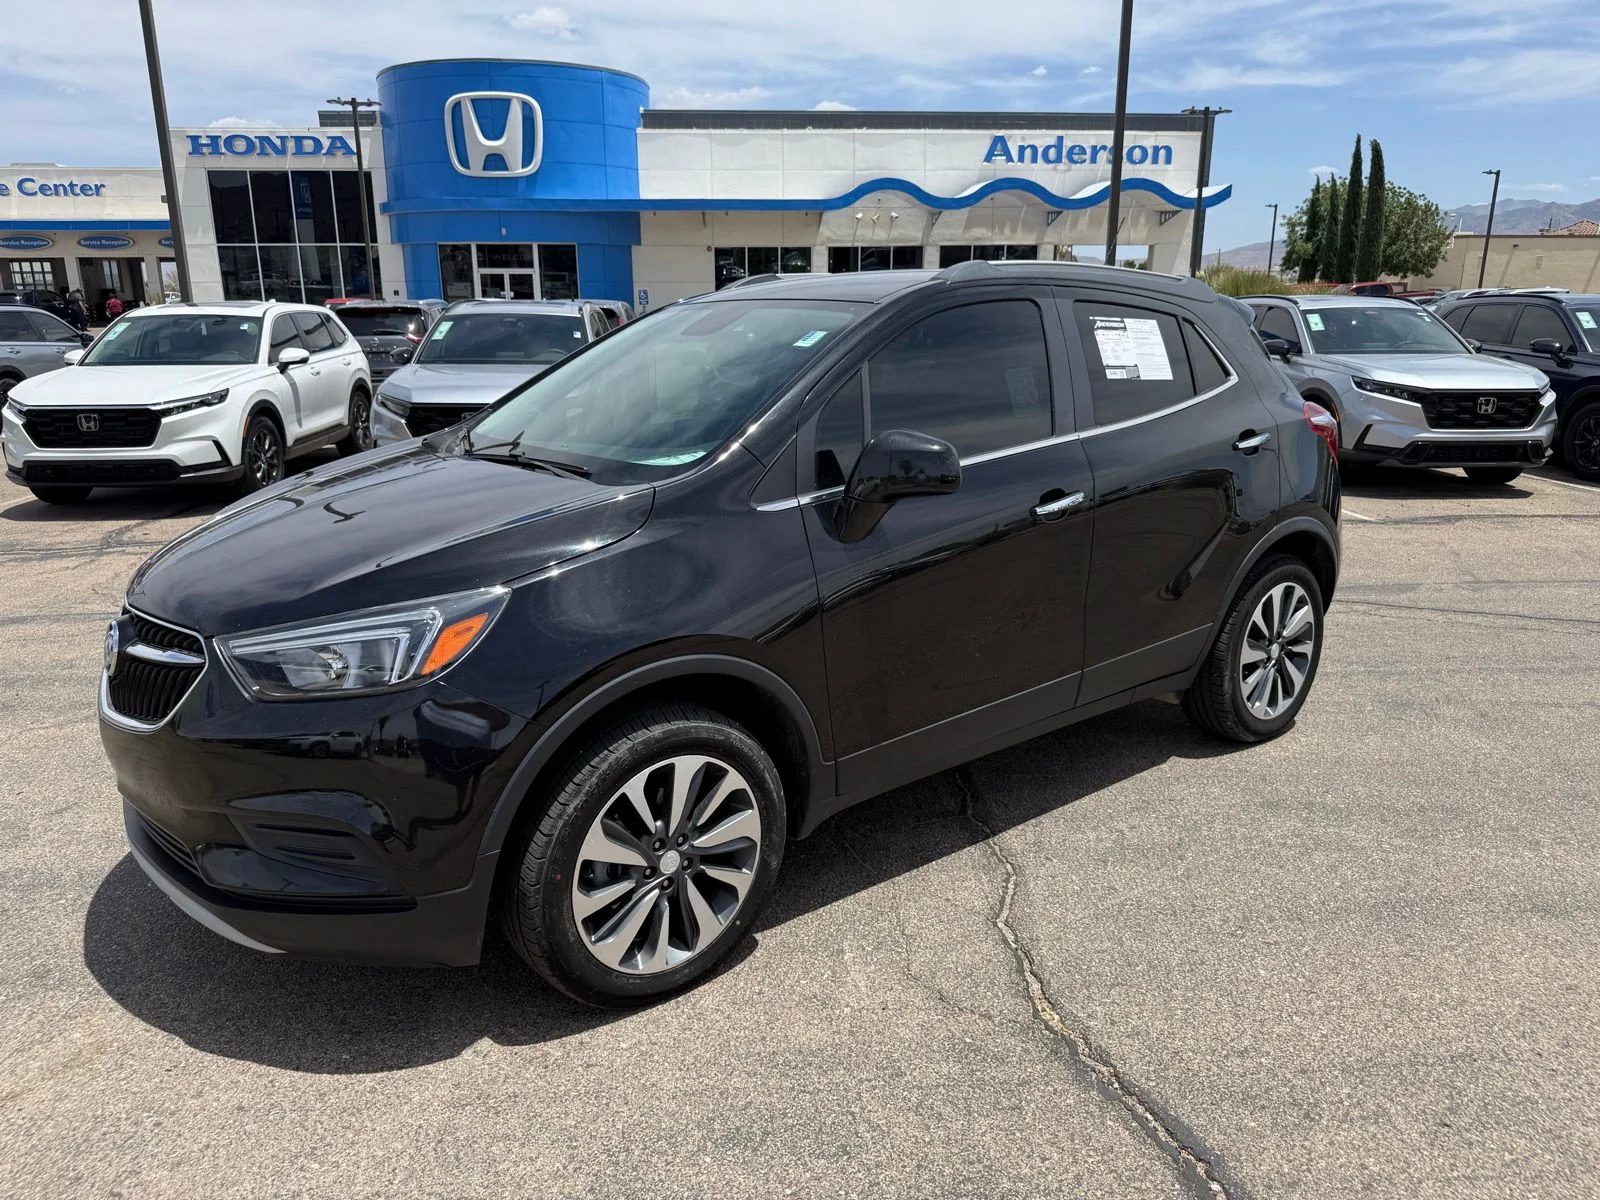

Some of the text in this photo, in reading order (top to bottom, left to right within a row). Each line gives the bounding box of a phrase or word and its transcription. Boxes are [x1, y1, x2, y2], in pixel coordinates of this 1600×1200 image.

[186, 134, 357, 156] HONDA
[17, 177, 105, 197] Center
[101, 239, 130, 247] Reception
